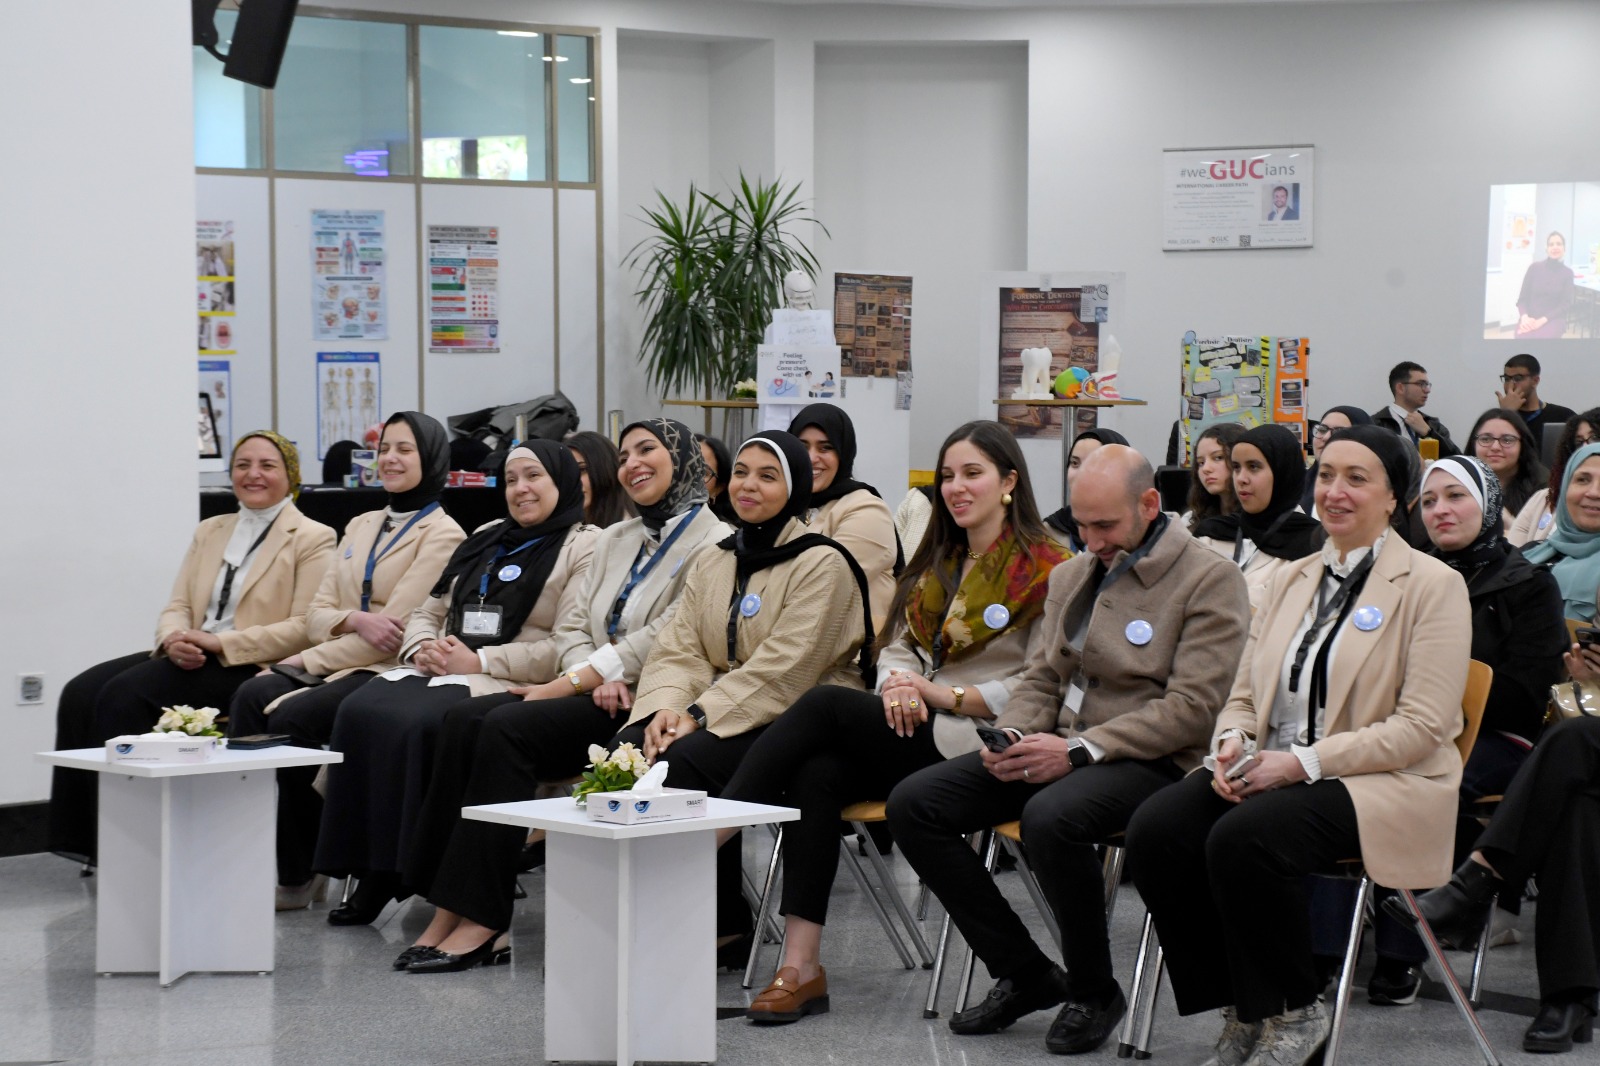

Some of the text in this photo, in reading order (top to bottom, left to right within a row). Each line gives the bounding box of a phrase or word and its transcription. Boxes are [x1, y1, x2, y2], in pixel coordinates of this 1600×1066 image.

[1011, 291, 1081, 302] FORENSIC DENTISTR
[783, 352, 803, 360] Feeling
[686, 798, 704, 806] SMART
